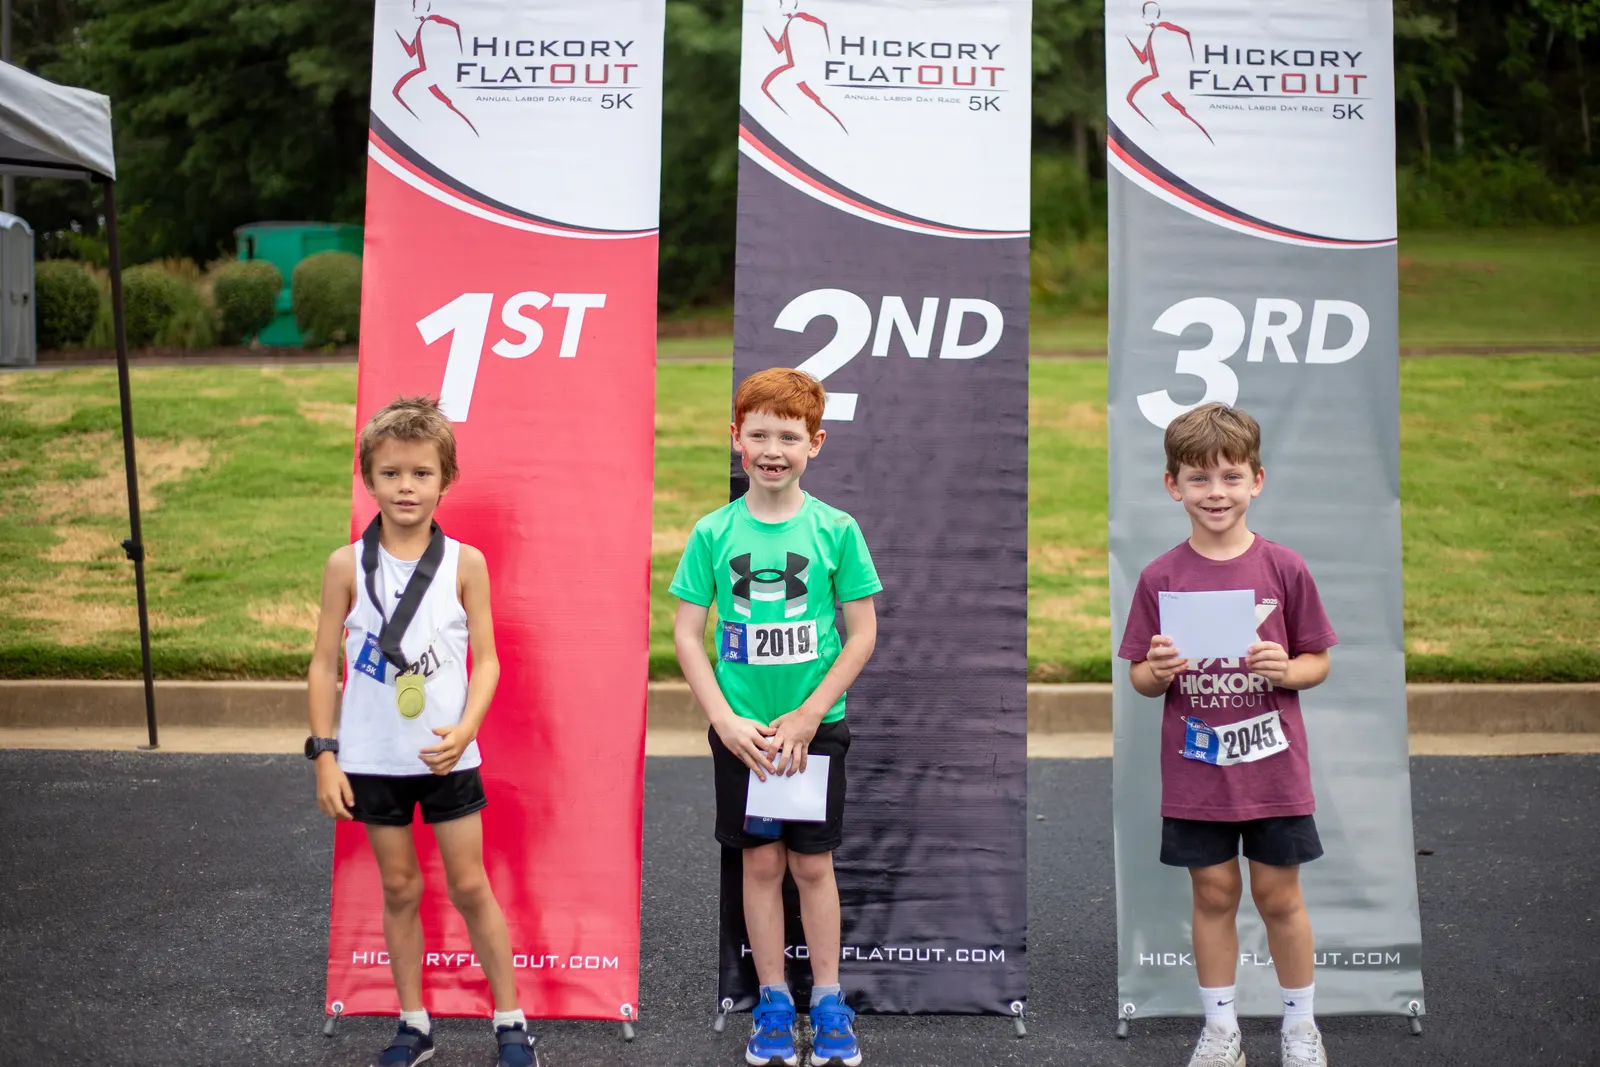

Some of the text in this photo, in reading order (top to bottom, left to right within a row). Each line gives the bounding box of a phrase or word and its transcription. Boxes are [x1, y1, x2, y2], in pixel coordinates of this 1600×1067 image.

[473, 36, 635, 57] HICKORY
[841, 35, 1001, 60] HICKORY
[1204, 44, 1363, 68] HICKORY
[456, 62, 639, 84] FLATOUT
[825, 60, 1005, 87] FLATOUT
[1189, 69, 1368, 95] FLATOUT
[515, 95, 545, 103] LABOR
[547, 95, 567, 103] DAY
[569, 95, 593, 103] RACE
[600, 93, 634, 109] 5K
[844, 93, 880, 102] ANNUAL
[915, 96, 935, 104] DAY
[968, 96, 1001, 112] 5K
[1209, 103, 1245, 111] ANNUAL
[1248, 104, 1277, 112] LABOR
[1332, 104, 1364, 120] 5K
[415, 290, 607, 422] 1ST
[773, 288, 1004, 421] 2ND
[1136, 296, 1370, 430] 3RD
[755, 625, 810, 657] 2019
[366, 665, 377, 675] 5K
[1190, 693, 1266, 709] FLATOUT
[1222, 718, 1277, 759] 2045
[1195, 750, 1207, 759] 5K
[352, 951, 619, 969] HICRYFLOUT.COM
[741, 944, 1005, 963] HKOFLATOUT.COM
